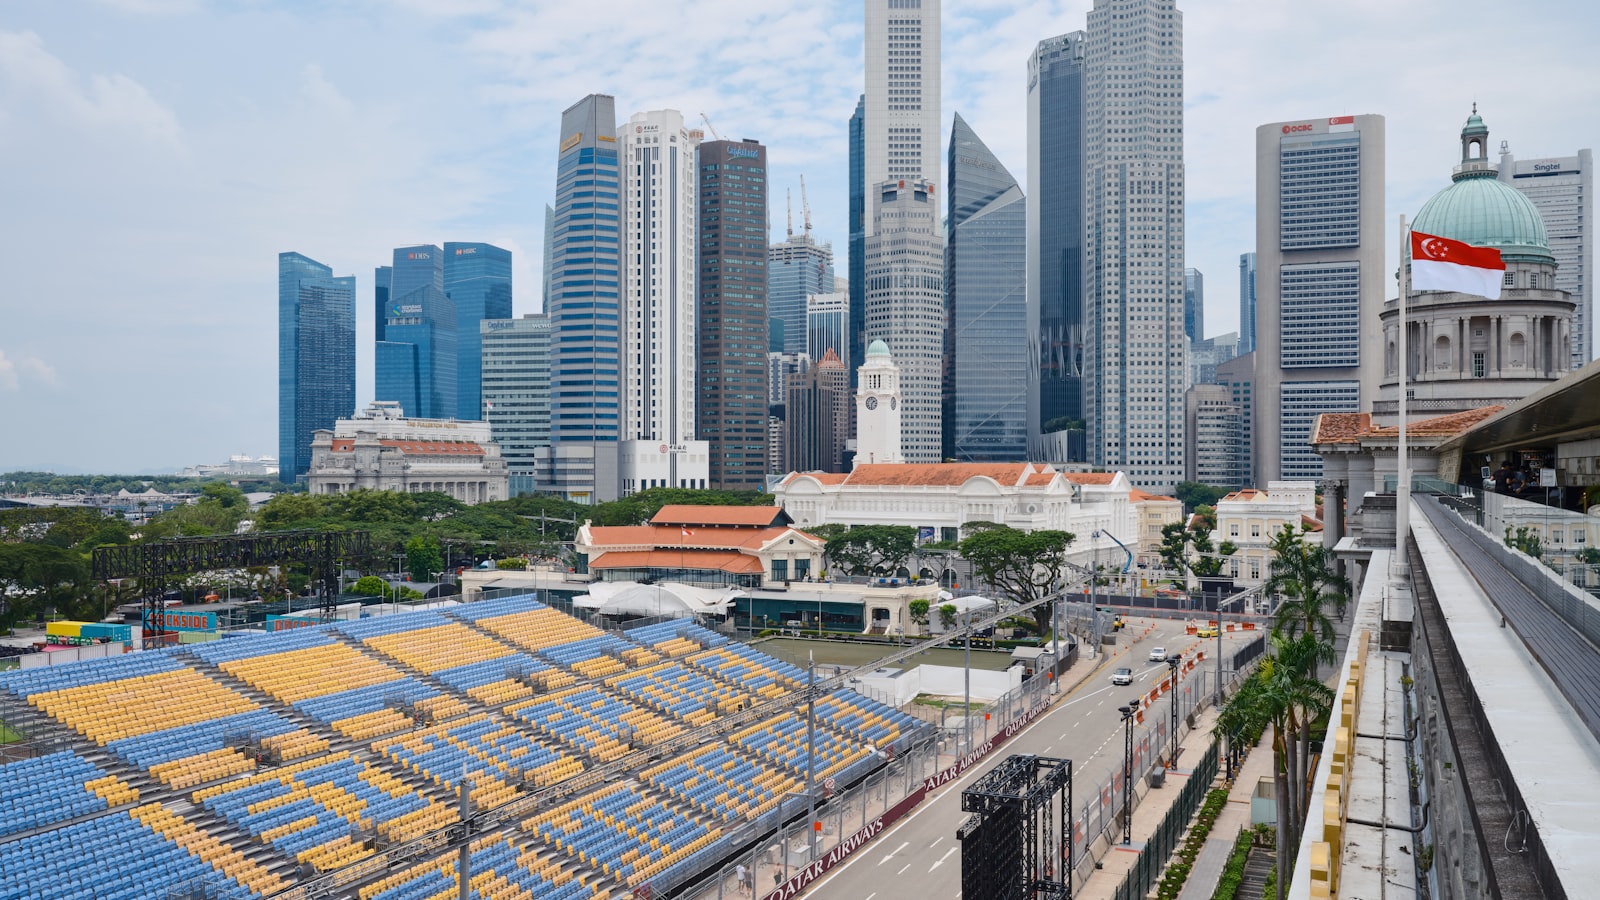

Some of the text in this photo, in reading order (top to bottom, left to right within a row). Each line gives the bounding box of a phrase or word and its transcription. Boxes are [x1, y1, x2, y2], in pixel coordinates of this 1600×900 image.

[1291, 124, 1313, 132] OCBC
[1534, 163, 1560, 171] Singtel
[1005, 698, 1051, 737] QATAR AIRWAYS
[958, 740, 993, 774] AIRWAYS
[827, 816, 884, 868] AIRWAYS
